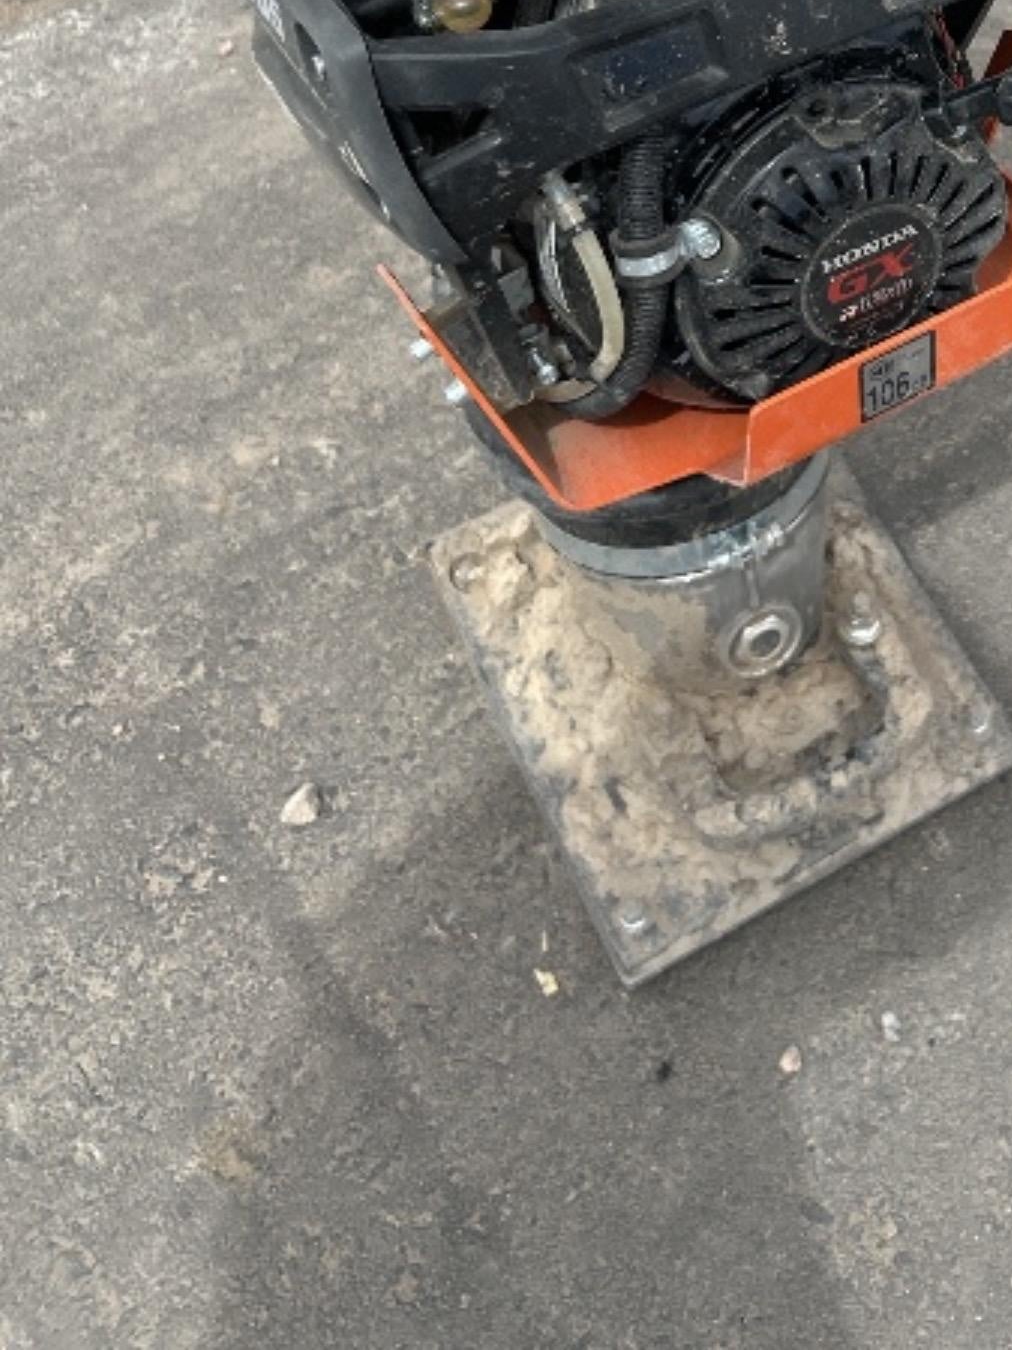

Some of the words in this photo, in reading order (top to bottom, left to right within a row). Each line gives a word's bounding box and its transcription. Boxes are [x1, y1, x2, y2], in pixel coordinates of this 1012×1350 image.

[821, 224, 919, 275] HONDA
[827, 241, 914, 304] GX
[866, 371, 910, 412] 106
